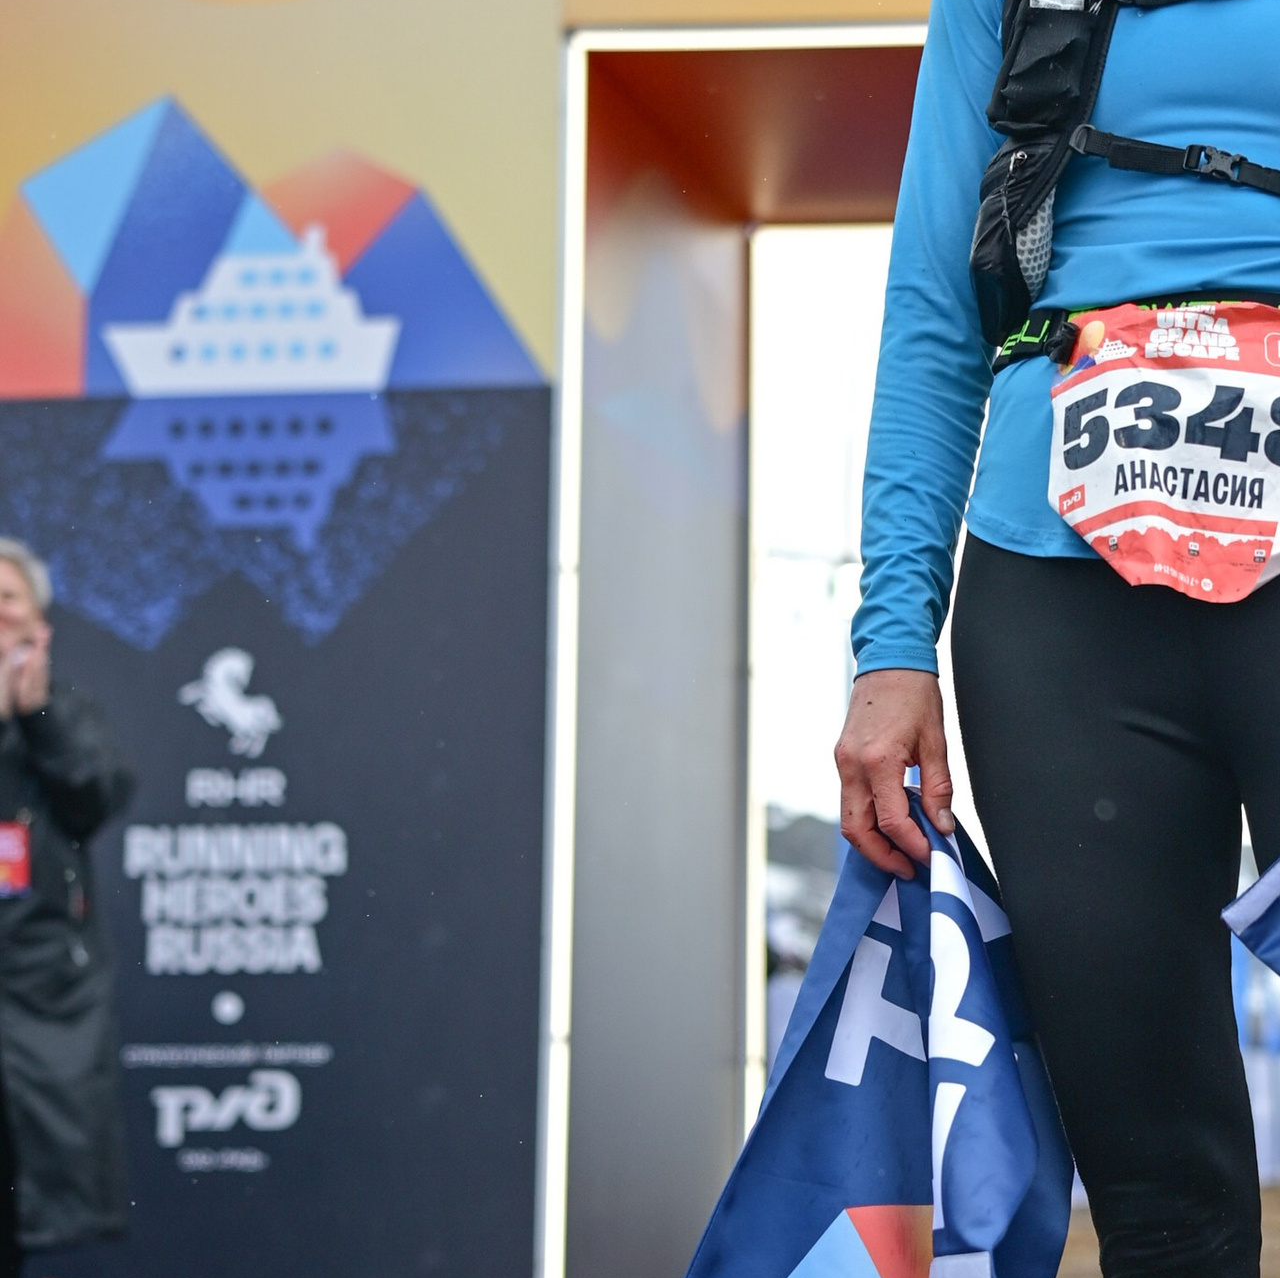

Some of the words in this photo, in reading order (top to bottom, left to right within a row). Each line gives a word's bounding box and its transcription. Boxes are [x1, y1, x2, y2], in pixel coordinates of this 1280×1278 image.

[1149, 327, 1236, 347] GRAND
[1156, 311, 1230, 334] ULTRA
[1144, 342, 1240, 361] ESCAPE
[1113, 460, 1265, 510] АНАСТАСИЯ
[124, 821, 348, 879] RUNNING
[140, 875, 329, 926] HEROES
[145, 922, 323, 976] RUSSIA
